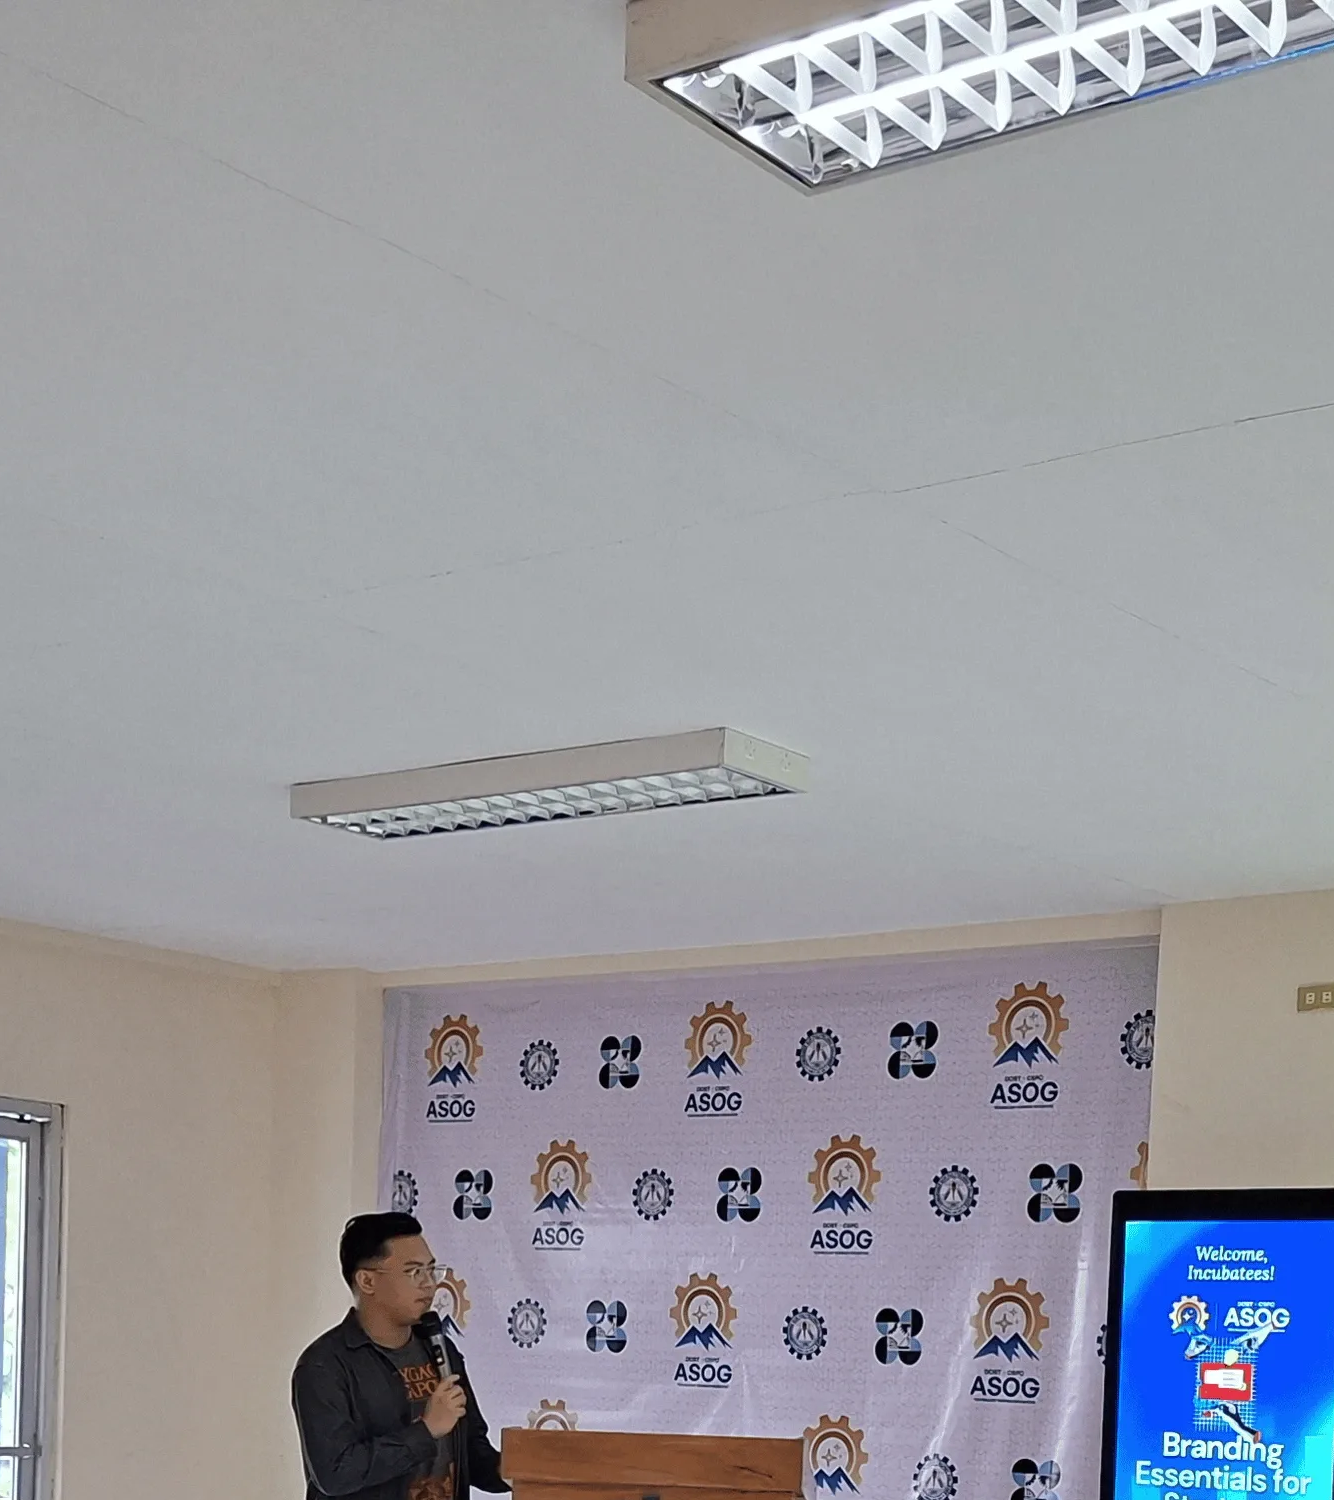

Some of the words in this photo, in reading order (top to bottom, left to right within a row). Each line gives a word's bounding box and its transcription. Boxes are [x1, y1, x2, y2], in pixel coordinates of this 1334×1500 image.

[684, 1092, 742, 1112] ASOG
[990, 1081, 1059, 1104] ASOG
[426, 1100, 475, 1118] ASOG
[532, 1227, 584, 1245] ASOG
[810, 1229, 873, 1249] ASOG
[1195, 1245, 1268, 1264] Welcome,
[1187, 1265, 1275, 1281] Incubatees!
[1224, 1307, 1291, 1328] ASOG
[674, 1363, 732, 1383] ASOG
[970, 1376, 1040, 1398] ASOG
[1163, 1431, 1284, 1469] Branding
[1135, 1460, 1267, 1493] Essentials
[1273, 1469, 1312, 1495] for
